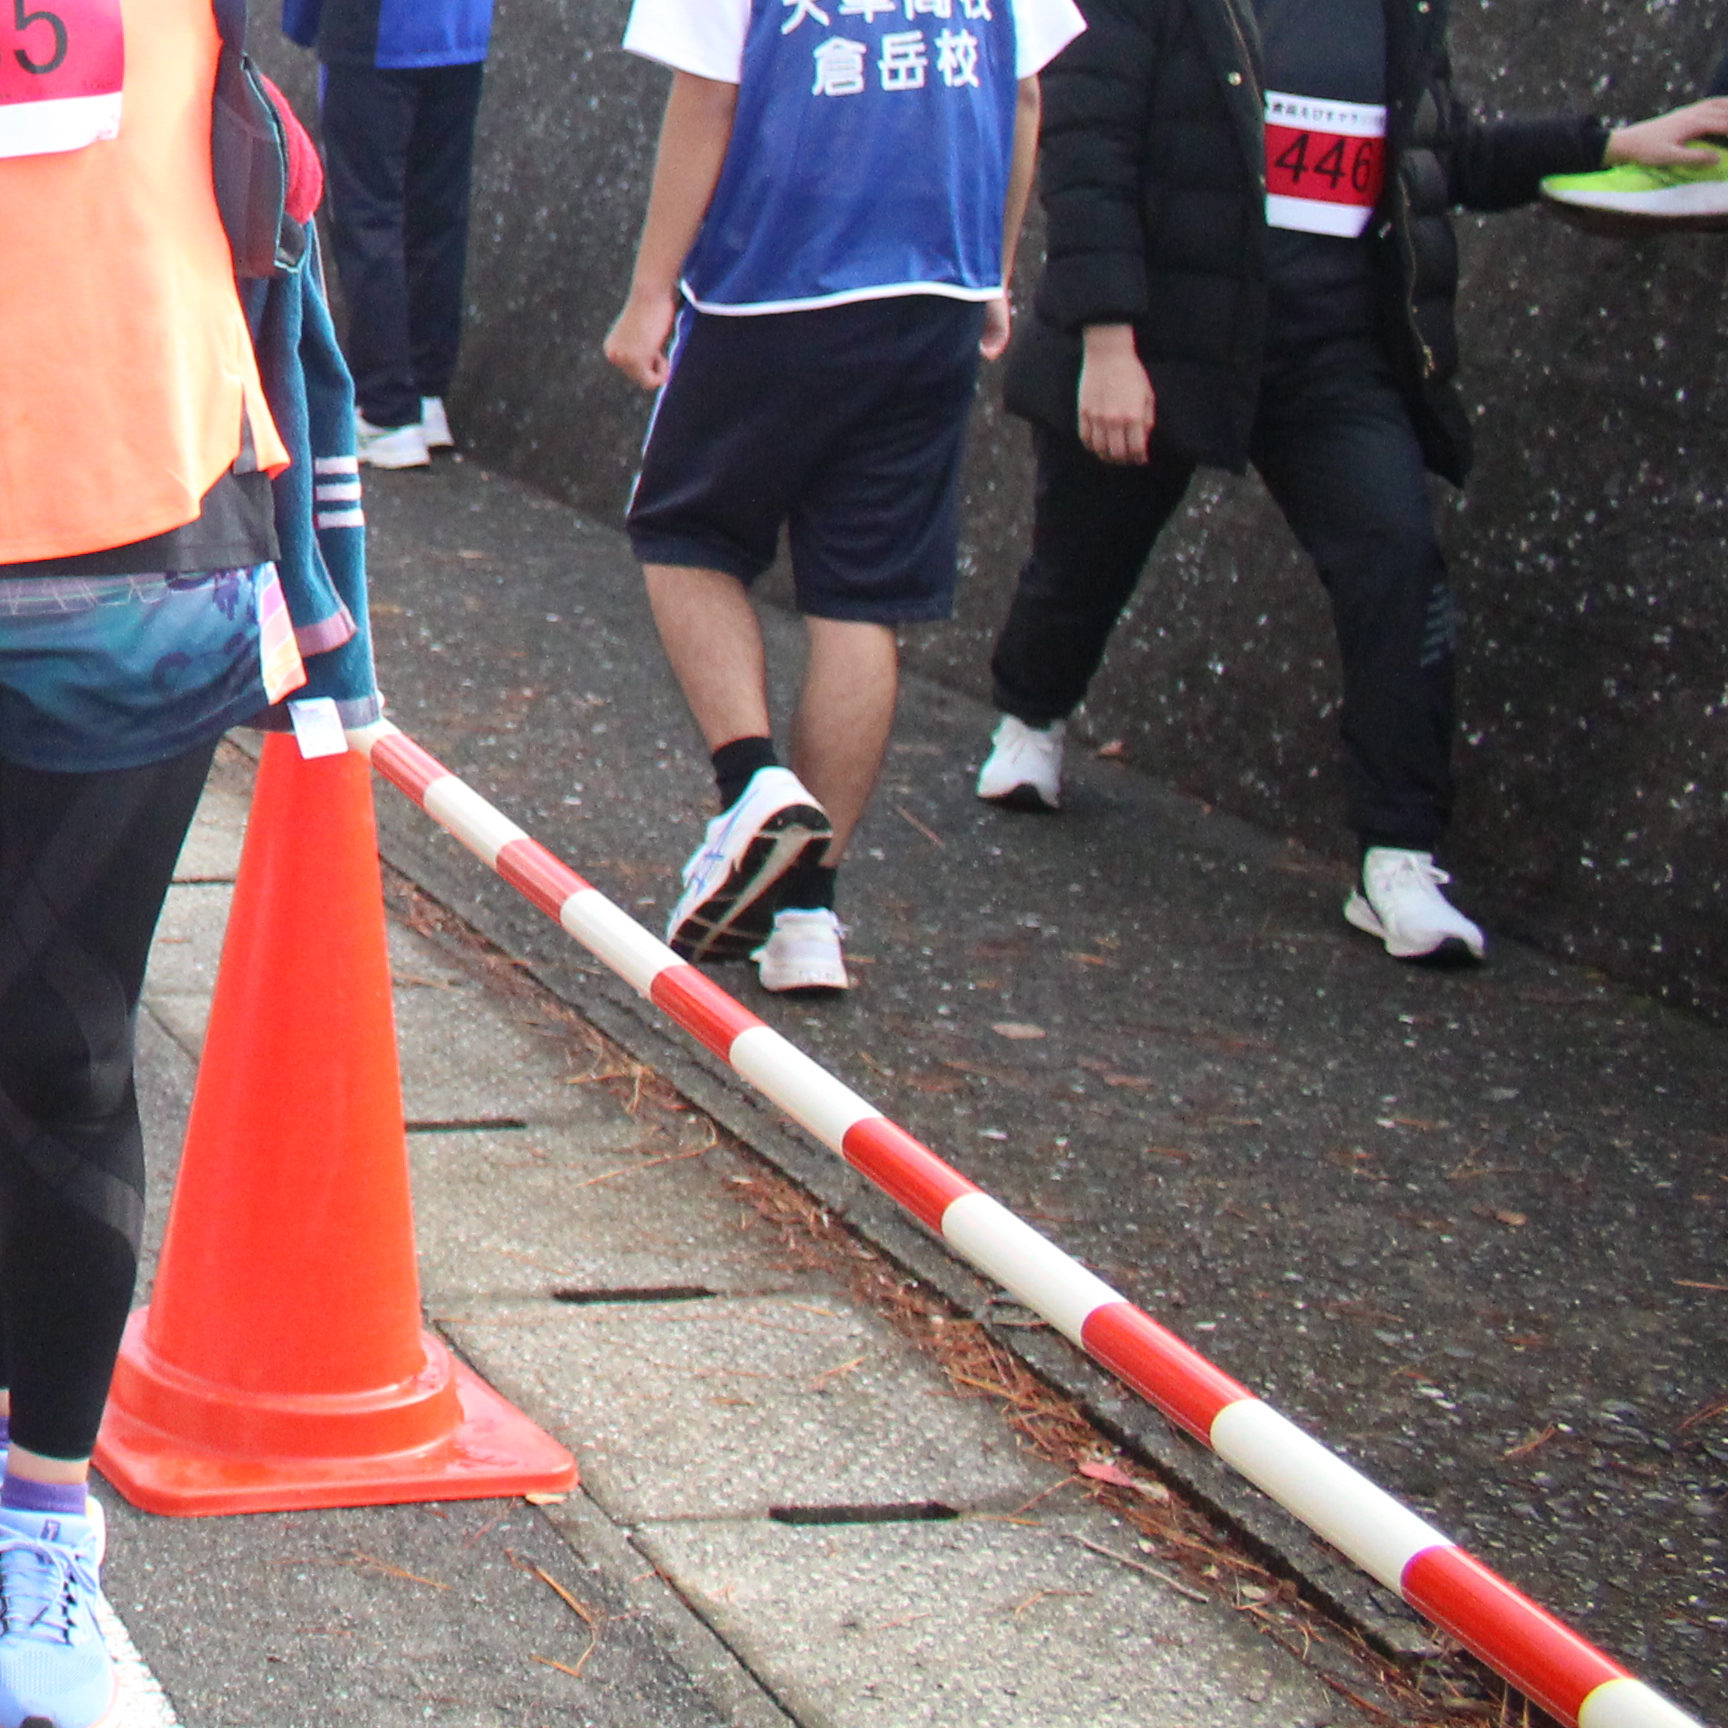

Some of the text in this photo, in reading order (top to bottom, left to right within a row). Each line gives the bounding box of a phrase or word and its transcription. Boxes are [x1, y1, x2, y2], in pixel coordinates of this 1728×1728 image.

[811, 27, 981, 98] 倉岳校
[1274, 132, 1374, 194] 446
